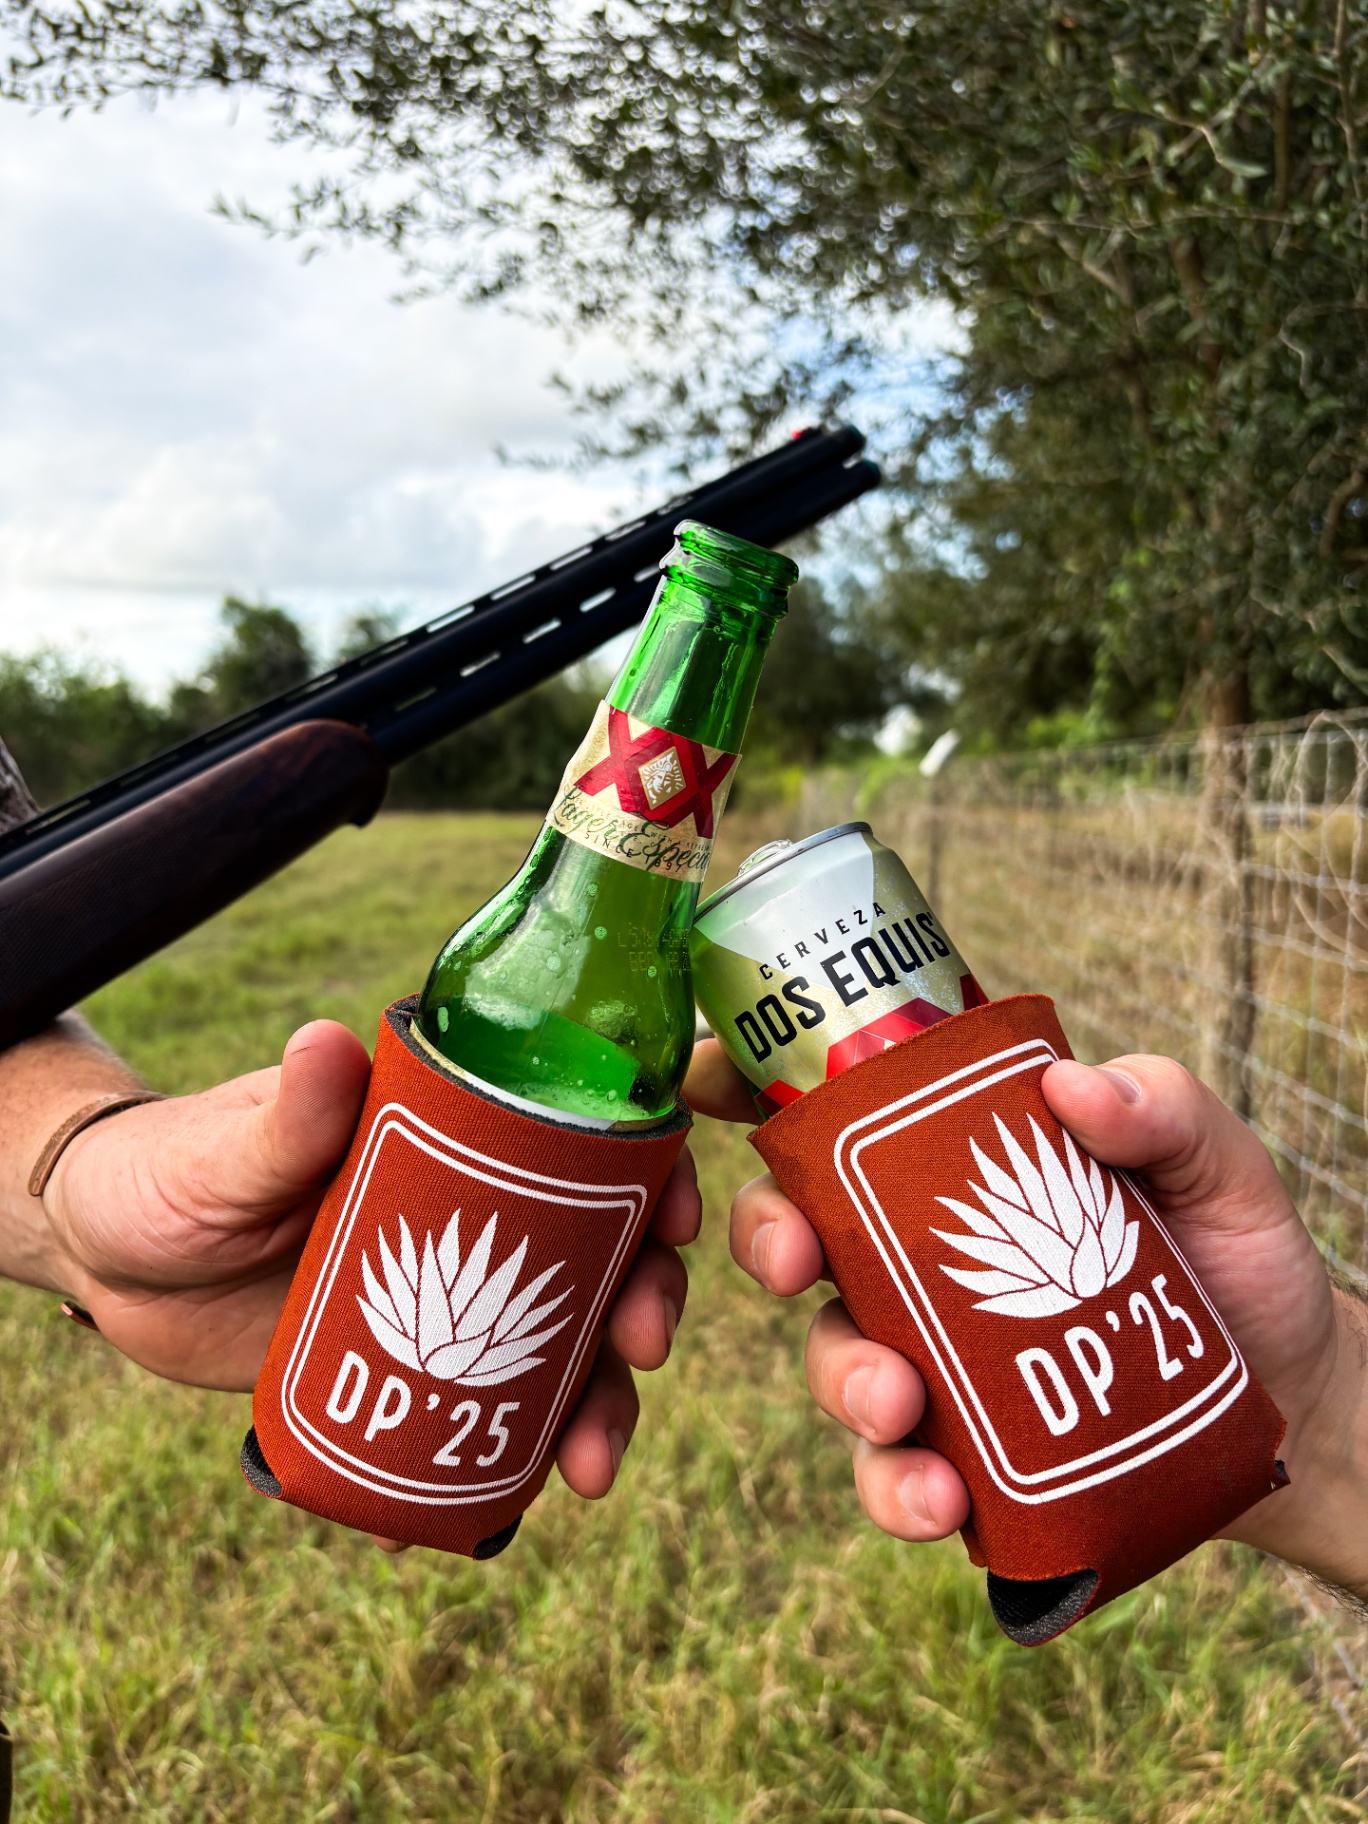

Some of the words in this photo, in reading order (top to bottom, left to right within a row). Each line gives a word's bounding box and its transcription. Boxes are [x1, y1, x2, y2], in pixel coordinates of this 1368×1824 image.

[553, 784, 620, 839] Lager
[584, 831, 635, 858] SINCE
[734, 976, 826, 1064] DOS
[819, 912, 951, 1008] EQUIS
[759, 902, 886, 981] CERVEZA
[1014, 1273, 1205, 1437] DP'25
[325, 1350, 521, 1468] DP'25
